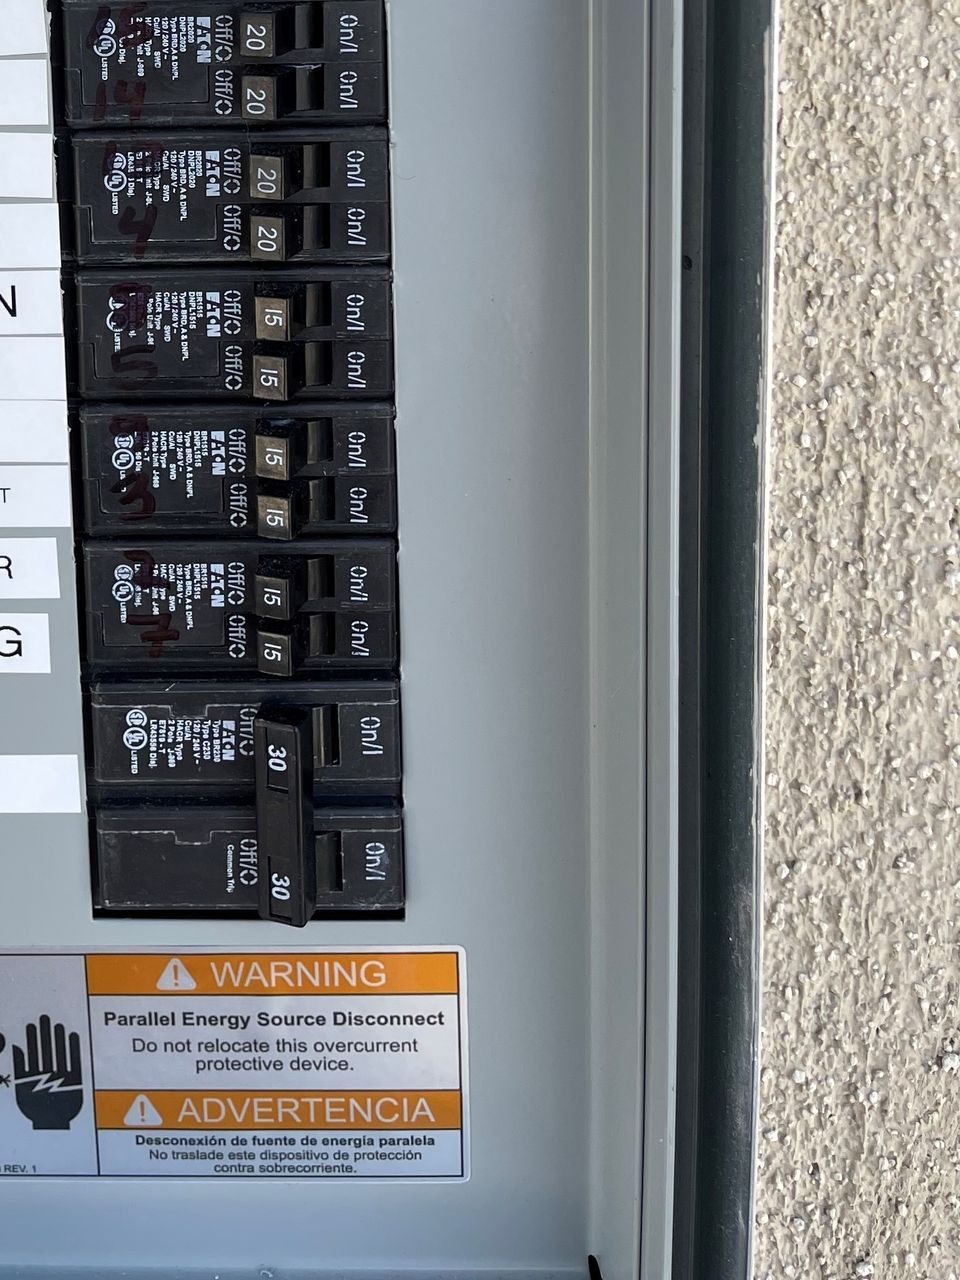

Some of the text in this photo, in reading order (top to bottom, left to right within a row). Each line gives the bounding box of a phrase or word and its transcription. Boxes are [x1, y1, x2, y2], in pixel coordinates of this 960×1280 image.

[247, 24, 266, 51] 20
[247, 88, 266, 115] 20
[257, 168, 276, 194] 20
[257, 226, 277, 252] 20
[264, 308, 283, 327] 15
[260, 367, 279, 388] 15
[265, 446, 283, 466] 15
[266, 508, 284, 527] 15
[263, 587, 281, 606] 15
[264, 642, 282, 661] 15
[268, 744, 288, 772] 30
[226, 844, 235, 878] Common
[272, 872, 291, 901] 30
[210, 960, 387, 988] WARNING
[103, 1011, 445, 1030] Parallel Energy Source Disconnect
[132, 1038, 419, 1053] Do not relocate this overcurrent
[195, 1056, 354, 1074] protective device.
[177, 1097, 436, 1124] ADVERTENCIA
[135, 1134, 435, 1149] Desconexión de fuente de energía paralela
[149, 1149, 422, 1163] No traslade este dispositivo de protección
[4, 1164, 29, 1174] REV.
[31, 1164, 37, 1173] 1
[214, 1163, 357, 1174] contra sobrecorriente.
